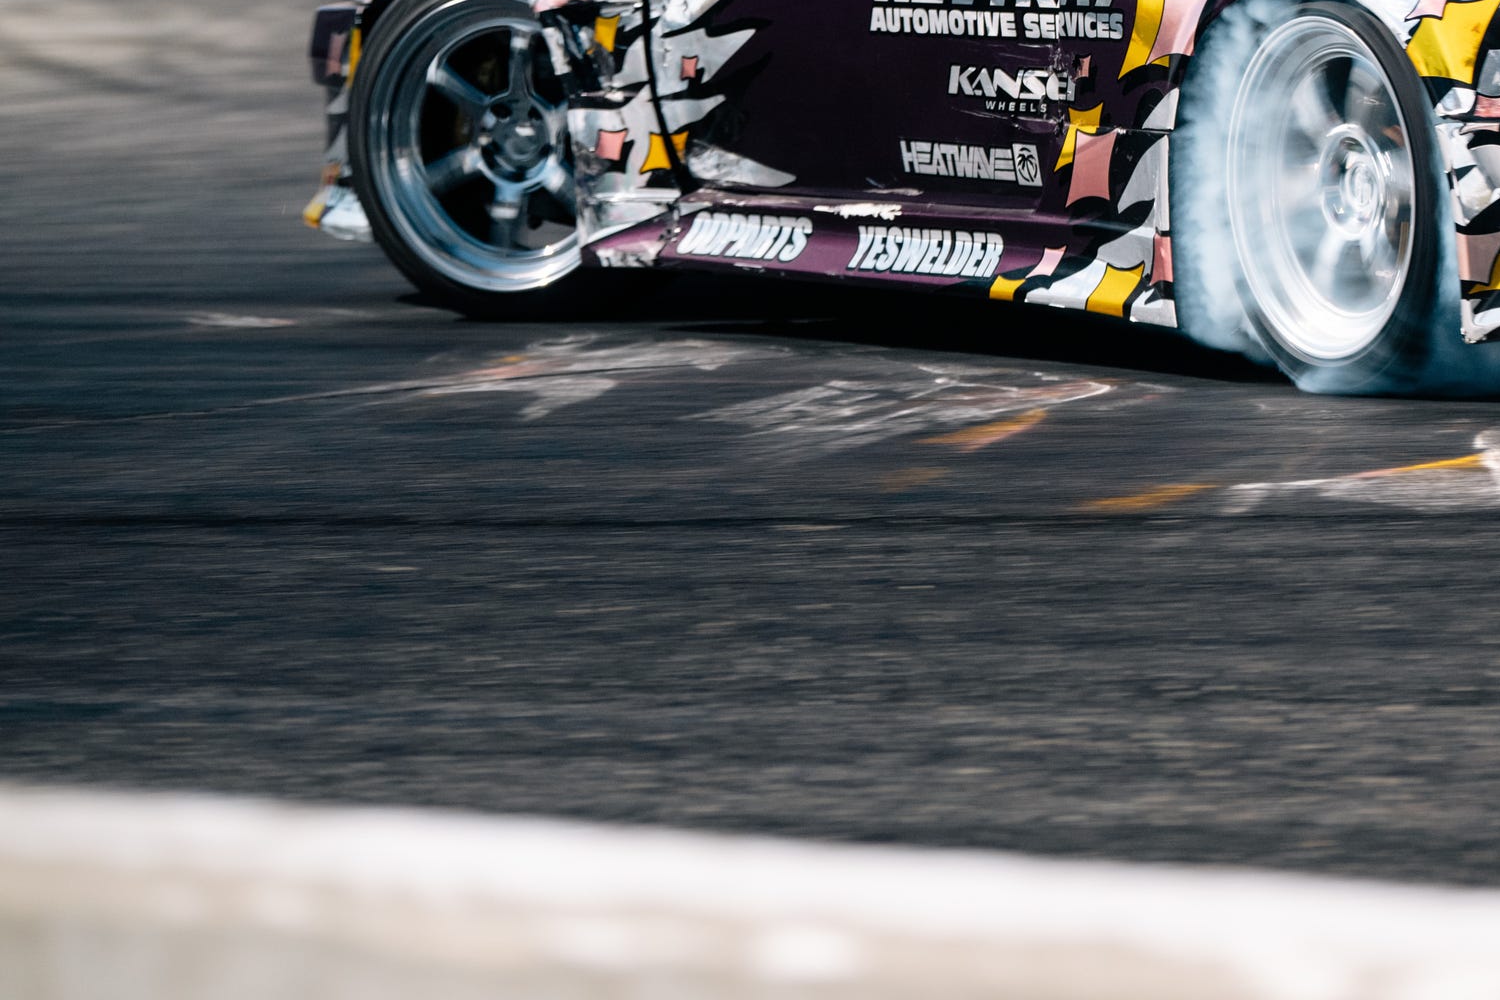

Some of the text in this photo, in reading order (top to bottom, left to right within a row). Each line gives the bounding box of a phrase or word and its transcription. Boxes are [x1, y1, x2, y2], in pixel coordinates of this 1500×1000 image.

[869, 6, 1124, 40] AUTOMOTIVE SERVICES
[948, 65, 1077, 102] KANSEI
[985, 101, 1047, 113] WHEELS
[900, 140, 1017, 182] HEATWAVE
[847, 225, 1004, 278] YESWELDER
